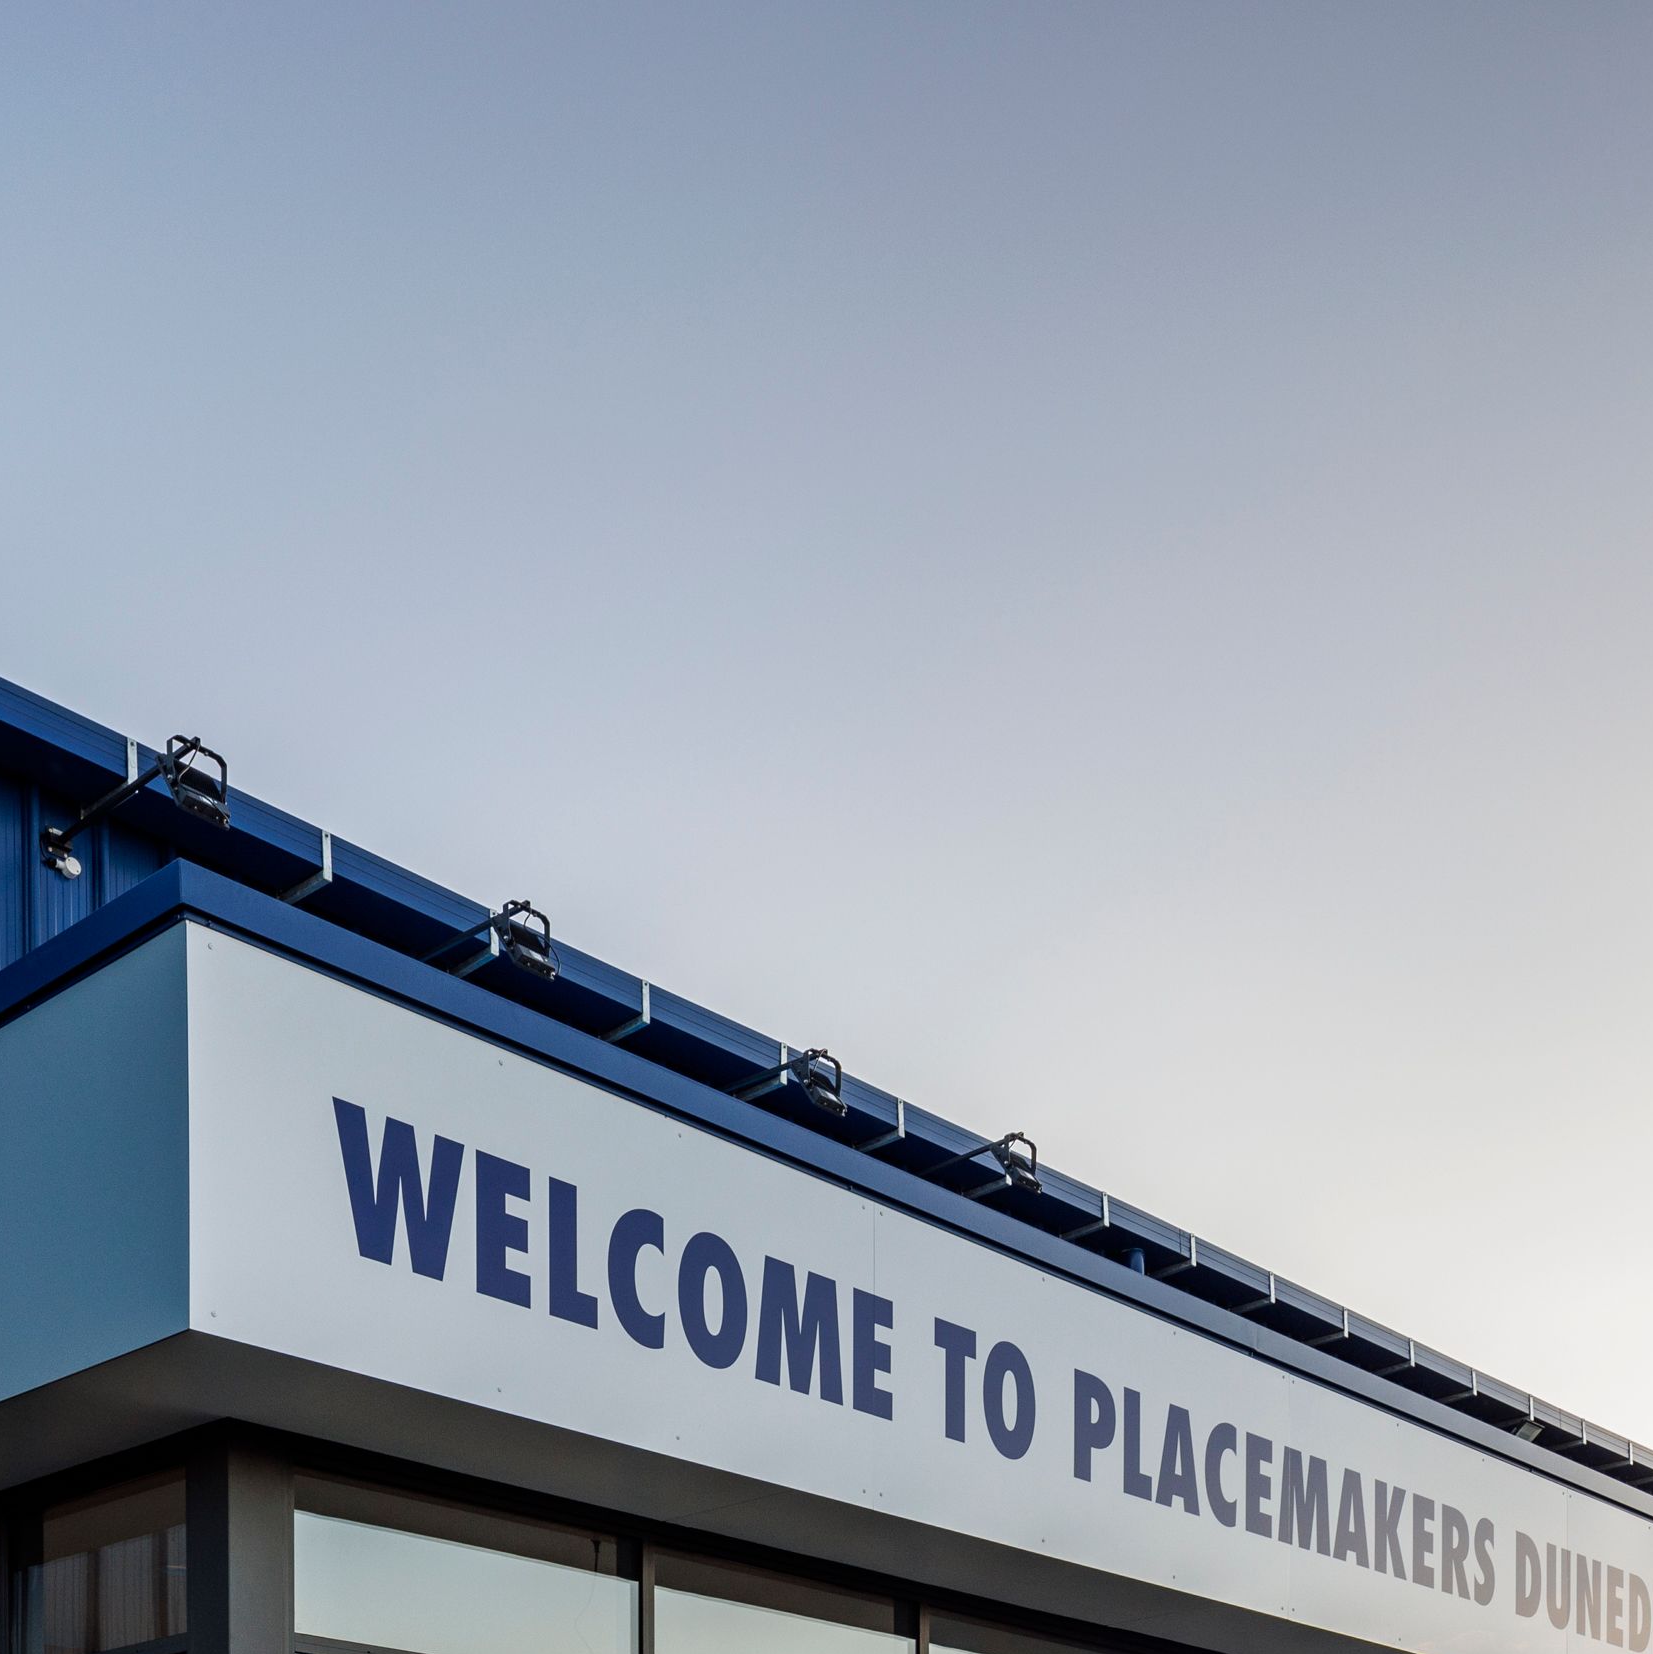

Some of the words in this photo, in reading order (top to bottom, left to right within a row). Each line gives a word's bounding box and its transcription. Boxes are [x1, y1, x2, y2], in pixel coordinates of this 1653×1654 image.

[332, 1096, 893, 1421] WELCOME
[934, 1317, 1036, 1461] TO
[1073, 1368, 1496, 1606] PLACEMAKERS
